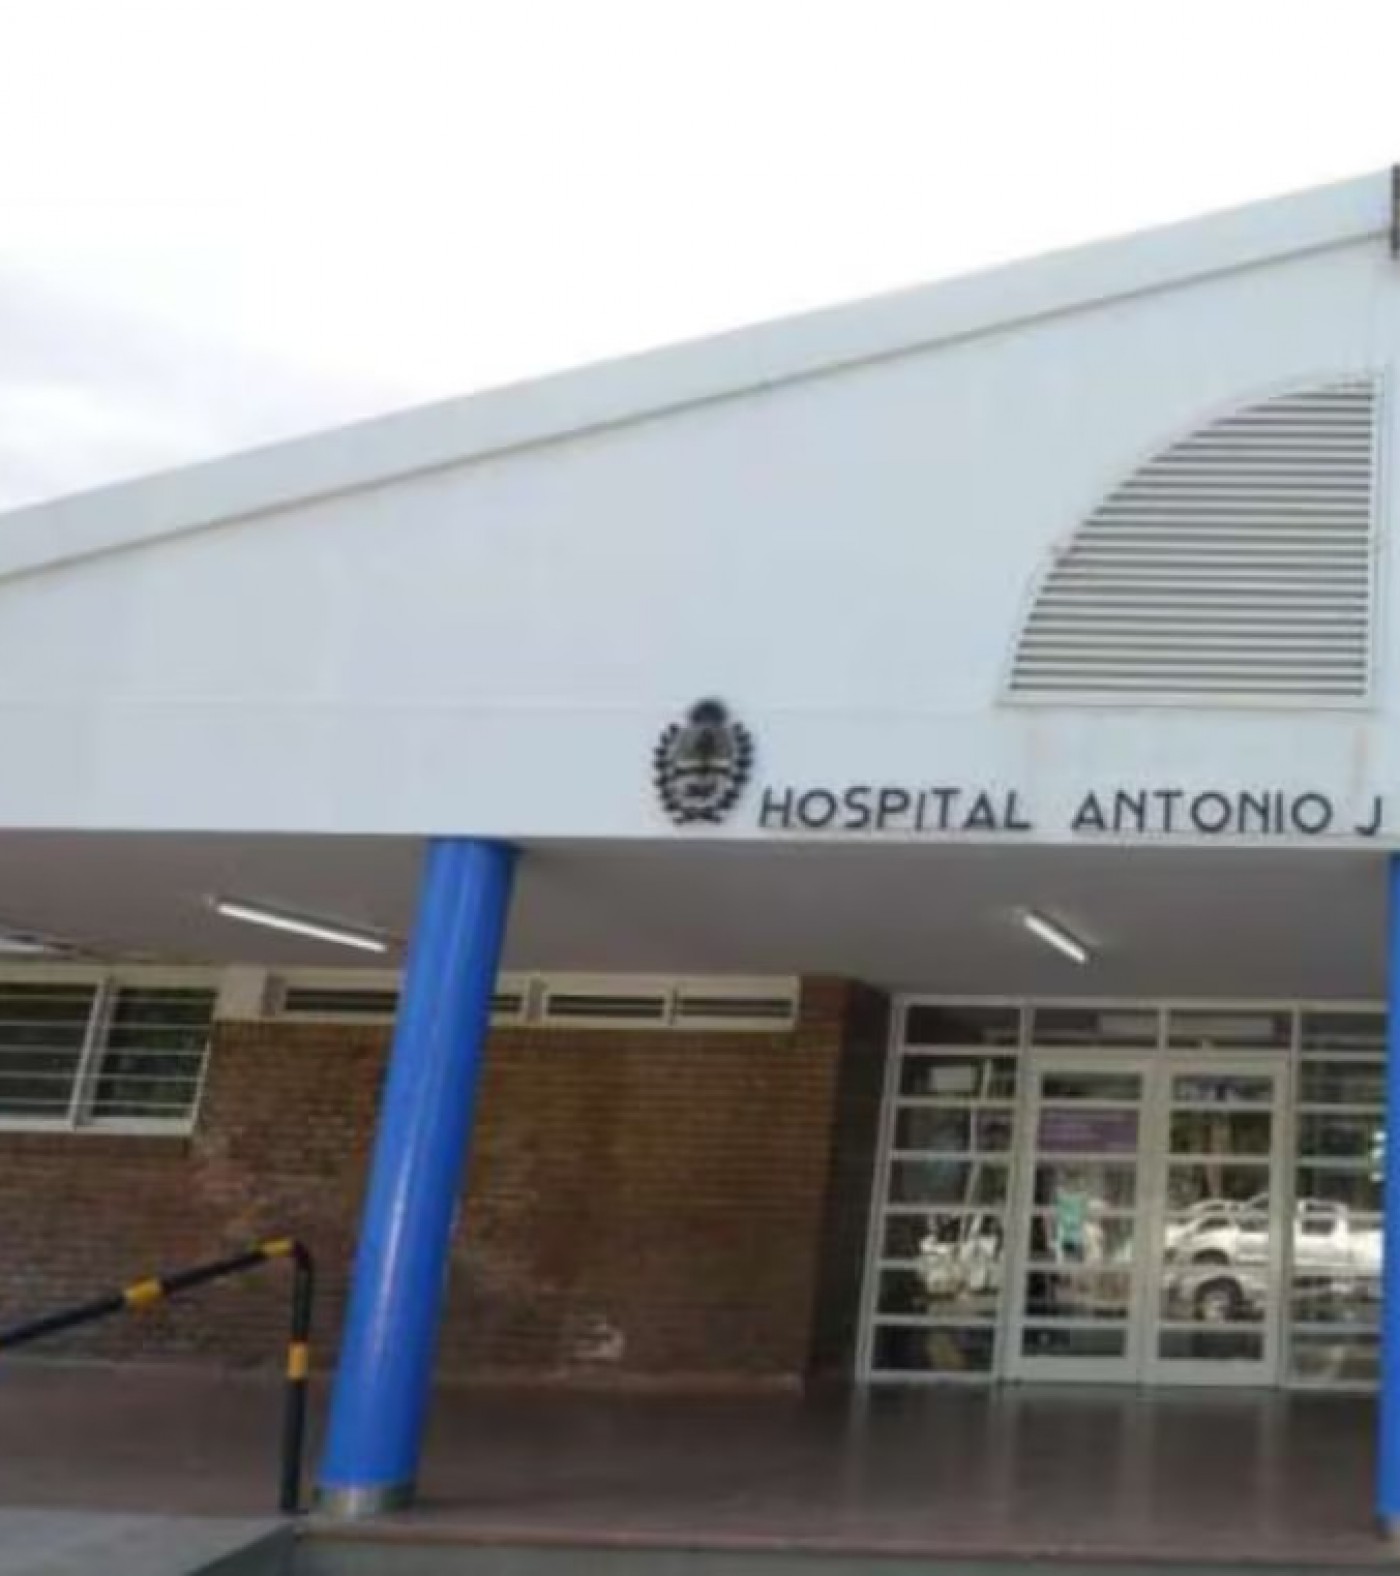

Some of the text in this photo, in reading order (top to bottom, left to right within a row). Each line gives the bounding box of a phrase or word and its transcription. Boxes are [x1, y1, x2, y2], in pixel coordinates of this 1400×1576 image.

[759, 786, 1032, 832] HOSPITAL
[1071, 790, 1333, 835] ANTONIO
[1355, 796, 1383, 837] J
